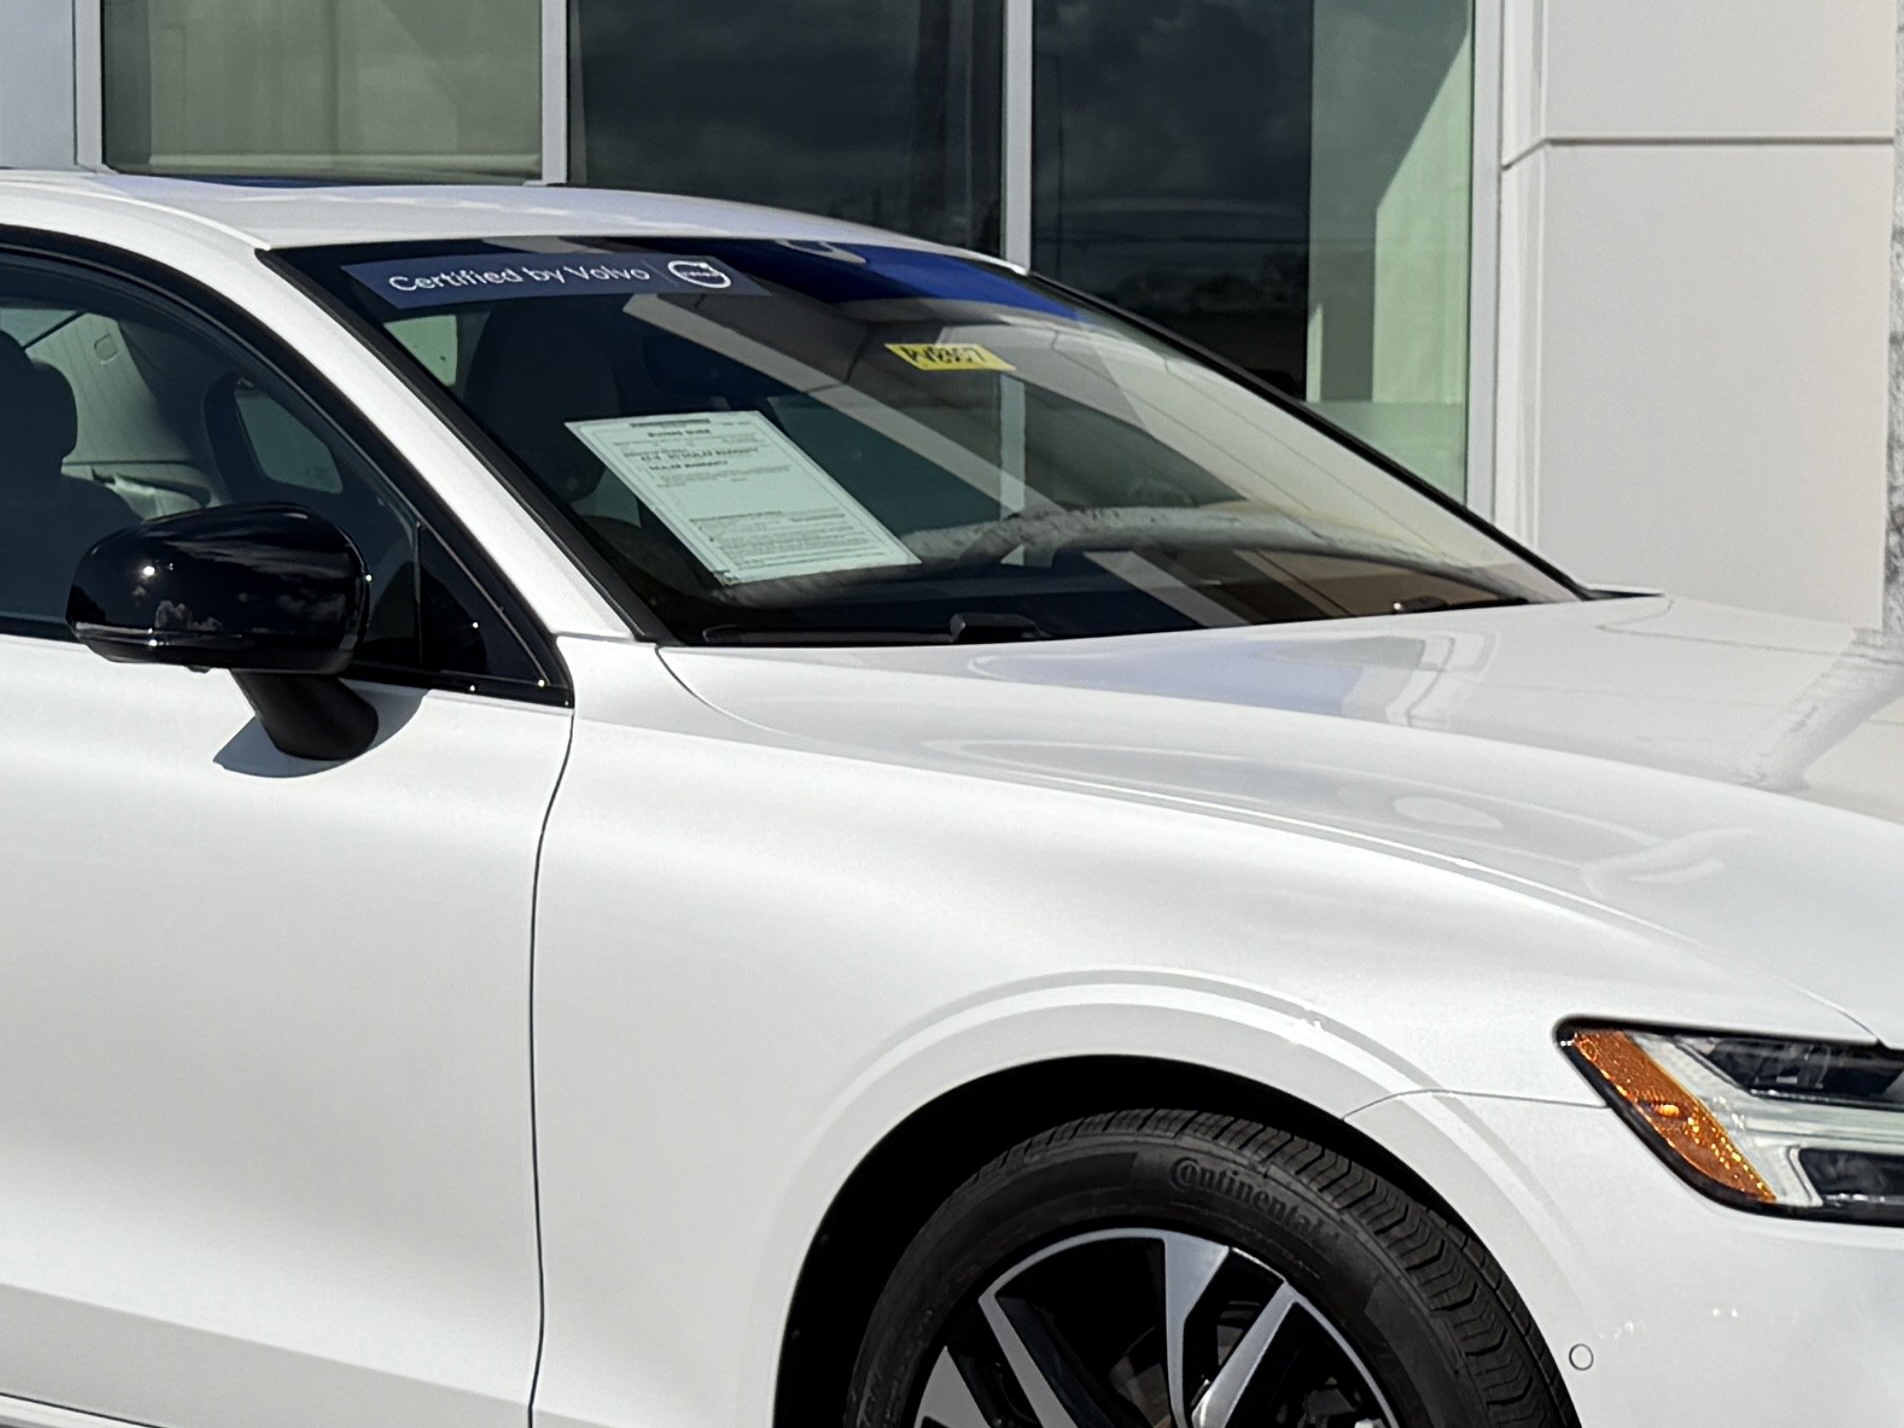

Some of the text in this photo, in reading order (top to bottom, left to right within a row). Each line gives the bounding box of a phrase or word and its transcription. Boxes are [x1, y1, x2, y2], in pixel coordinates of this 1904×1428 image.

[389, 265, 650, 291] Certified by Volvo
[1169, 1156, 1326, 1238] Continental
